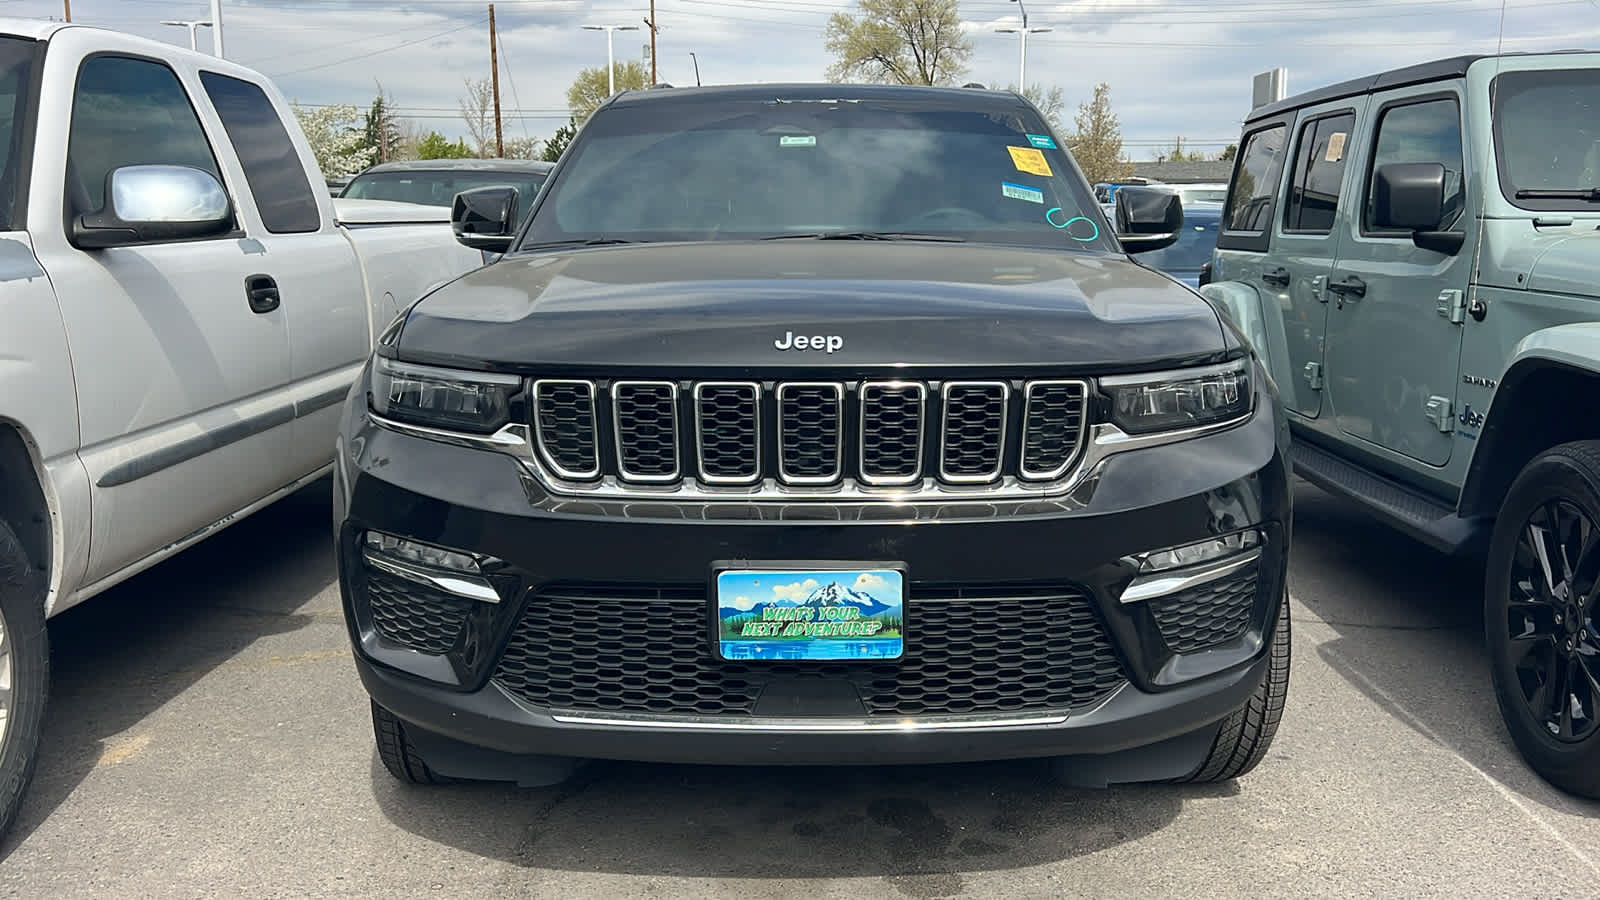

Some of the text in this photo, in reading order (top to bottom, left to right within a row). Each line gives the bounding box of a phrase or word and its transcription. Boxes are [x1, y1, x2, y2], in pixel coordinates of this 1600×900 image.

[775, 331, 843, 353] Jeep
[763, 606, 861, 621] WHAT'S YOUR
[741, 622, 883, 637] NEXT ADVENTURE?
